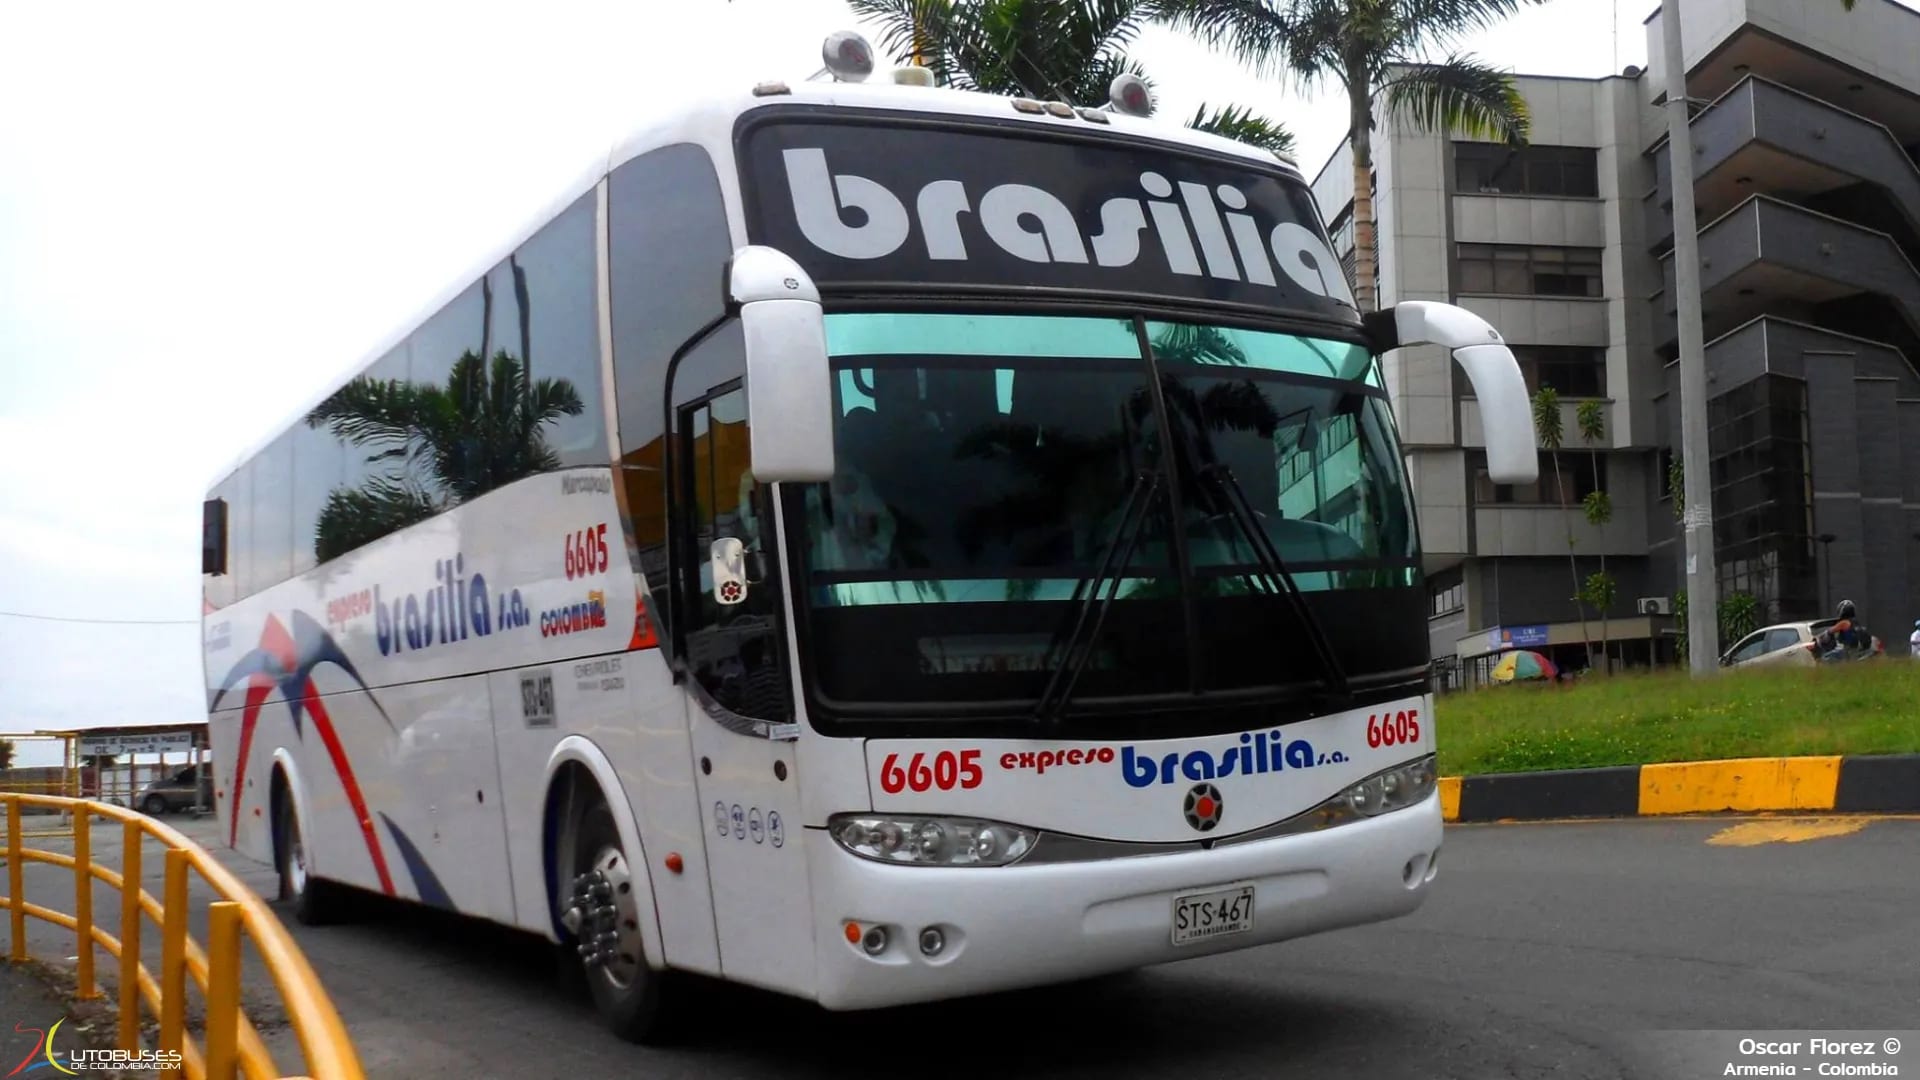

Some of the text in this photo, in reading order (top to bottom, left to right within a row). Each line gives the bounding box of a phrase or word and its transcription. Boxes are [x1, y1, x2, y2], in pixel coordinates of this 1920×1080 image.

[782, 147, 1358, 307] brasilia
[565, 523, 609, 581] 6605
[373, 552, 492, 657] brasilia
[1366, 710, 1420, 748] 6605
[880, 730, 1349, 794] 6605 expreso brasilia s.a.
[1178, 895, 1251, 930] STS-467
